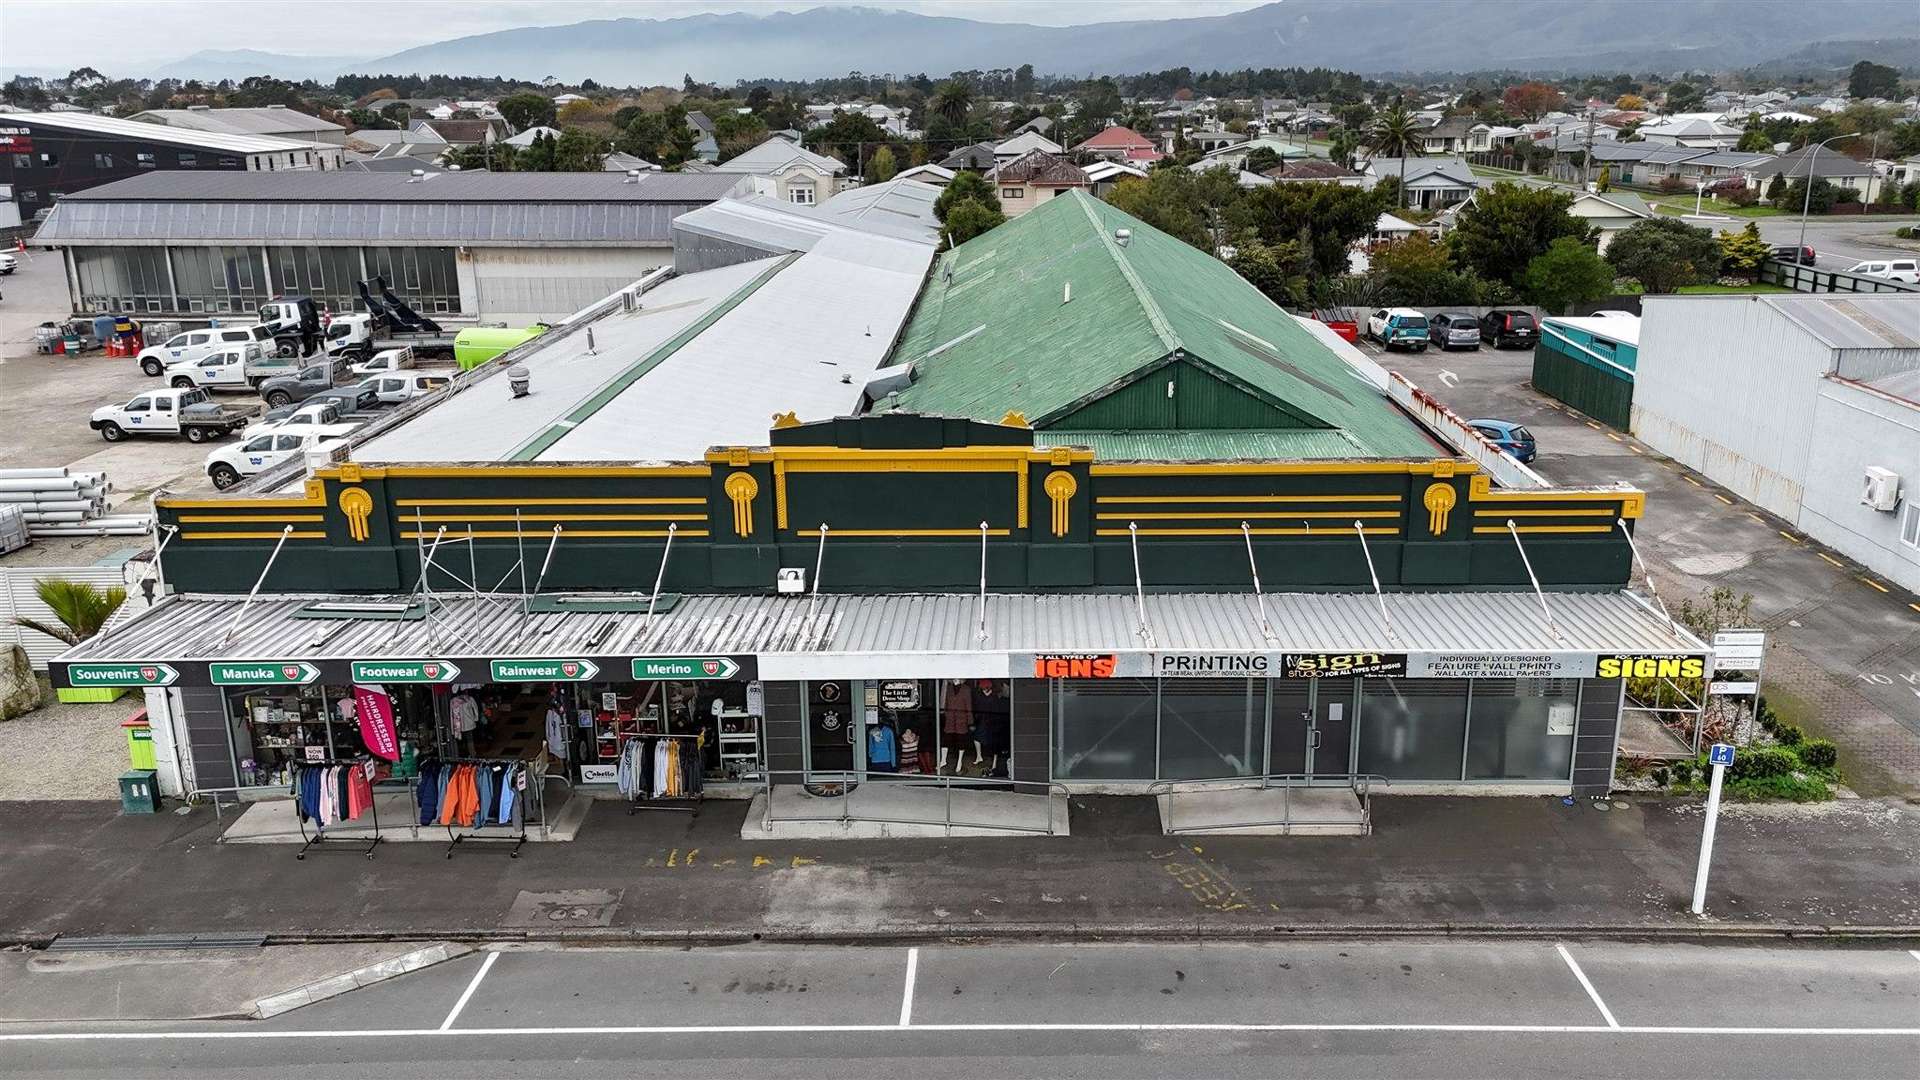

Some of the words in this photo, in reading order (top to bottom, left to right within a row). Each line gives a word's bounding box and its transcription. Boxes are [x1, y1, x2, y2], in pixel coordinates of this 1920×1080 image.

[499, 665, 558, 676] Rainwear
[647, 664, 692, 674] Merino
[1381, 662, 1401, 670] SIGNS
[1427, 662, 1480, 670] FEATURE
[1519, 662, 1562, 670] PRINTS
[1598, 659, 1704, 678] SIGNS
[76, 669, 140, 680] Souvenirs
[222, 668, 275, 679] Manuka
[360, 667, 419, 677] Footwear
[366, 694, 395, 753] HAIRDRESSERS
